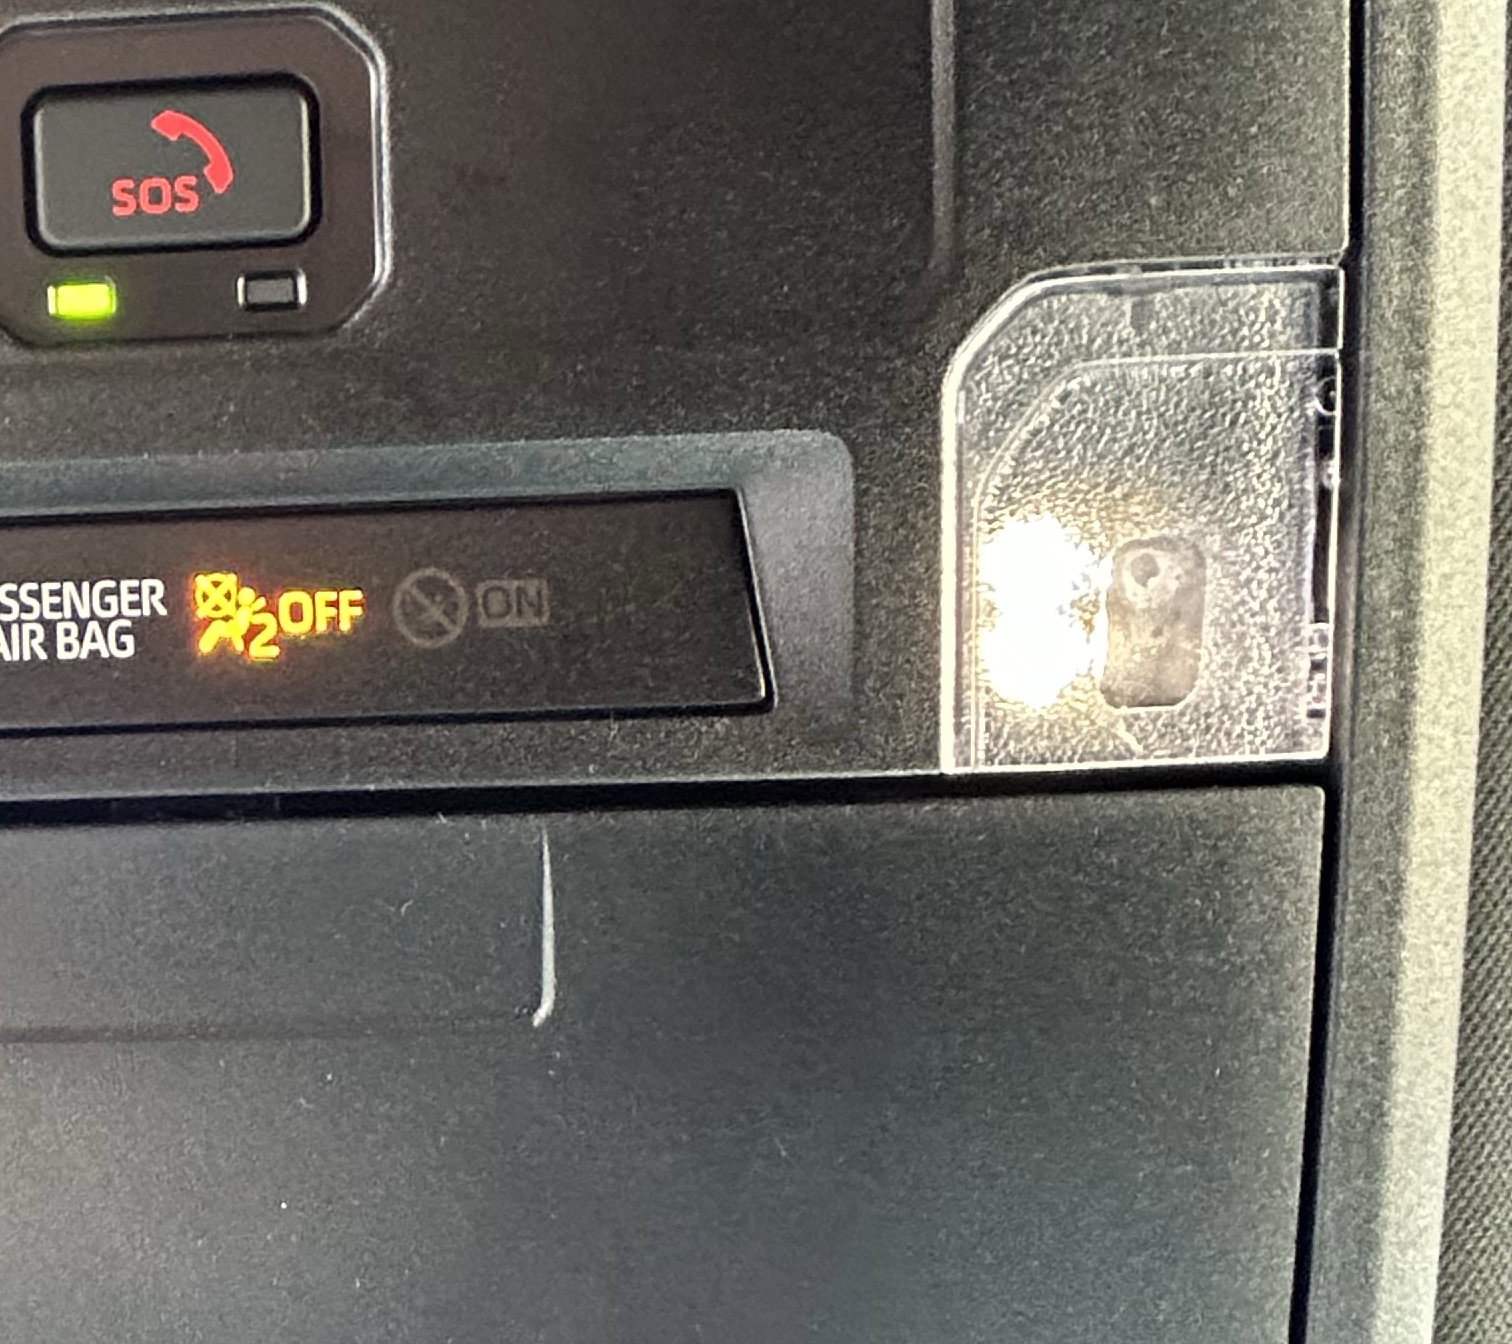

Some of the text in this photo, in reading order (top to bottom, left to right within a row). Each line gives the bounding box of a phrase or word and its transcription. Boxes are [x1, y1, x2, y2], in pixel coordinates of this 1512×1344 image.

[112, 175, 200, 216] SOS
[278, 588, 364, 634] OFF
[478, 581, 546, 625] ON
[56, 619, 136, 660] BAG
